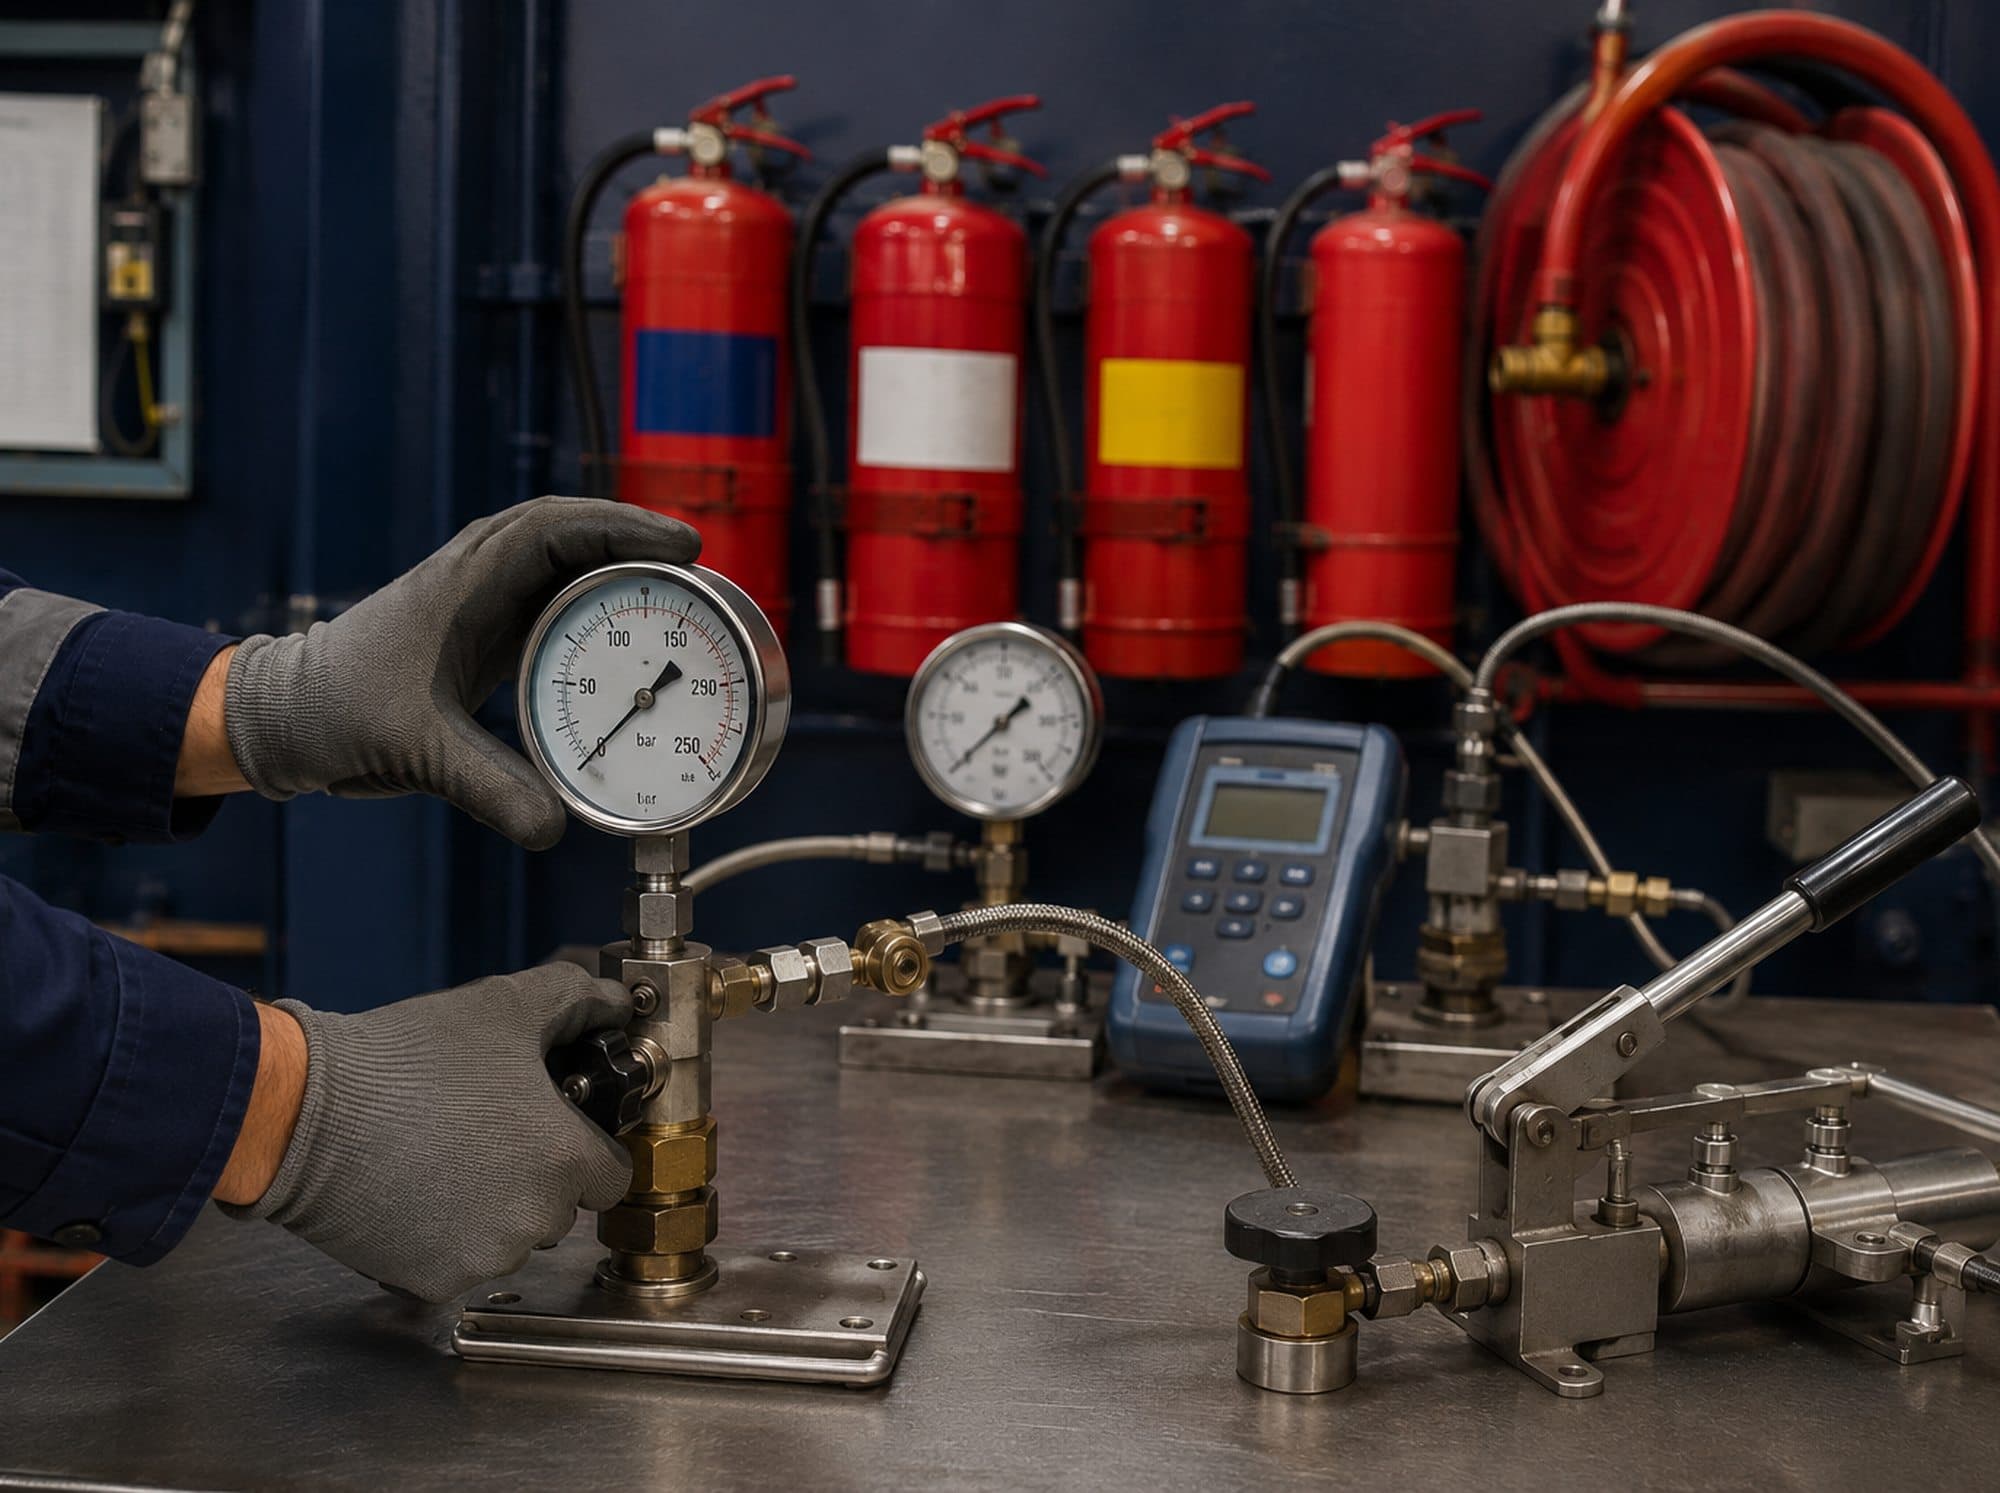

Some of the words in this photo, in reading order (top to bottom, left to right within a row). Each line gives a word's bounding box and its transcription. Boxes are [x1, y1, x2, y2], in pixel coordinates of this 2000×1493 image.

[607, 631, 630, 647] 100
[664, 631, 687, 647] 150
[580, 678, 596, 694] 50
[637, 733, 657, 747] bar
[675, 737, 700, 754] 250
